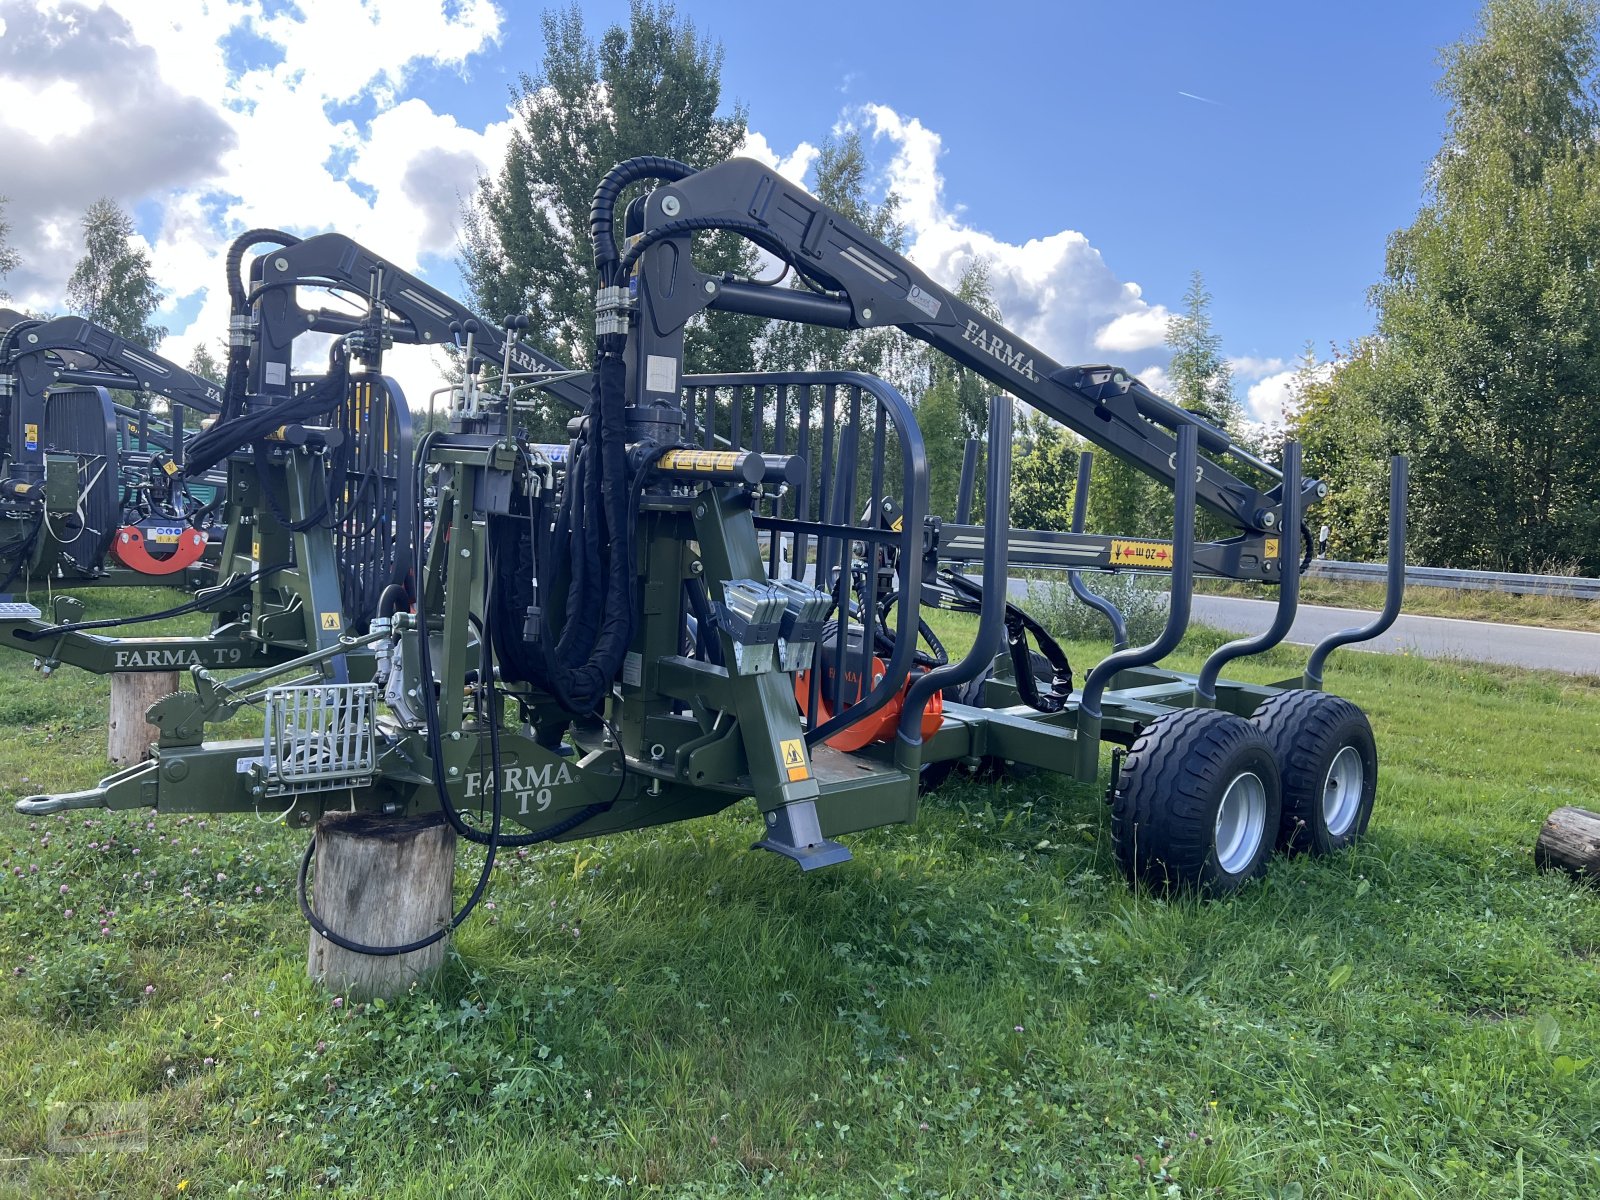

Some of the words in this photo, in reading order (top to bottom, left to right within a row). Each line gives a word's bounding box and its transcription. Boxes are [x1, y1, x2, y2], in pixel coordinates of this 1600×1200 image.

[1135, 547, 1144, 556] m
[1145, 548, 1156, 560] 20
[115, 649, 202, 668] FARMA
[213, 648, 241, 664] T9
[515, 788, 552, 815] T9
